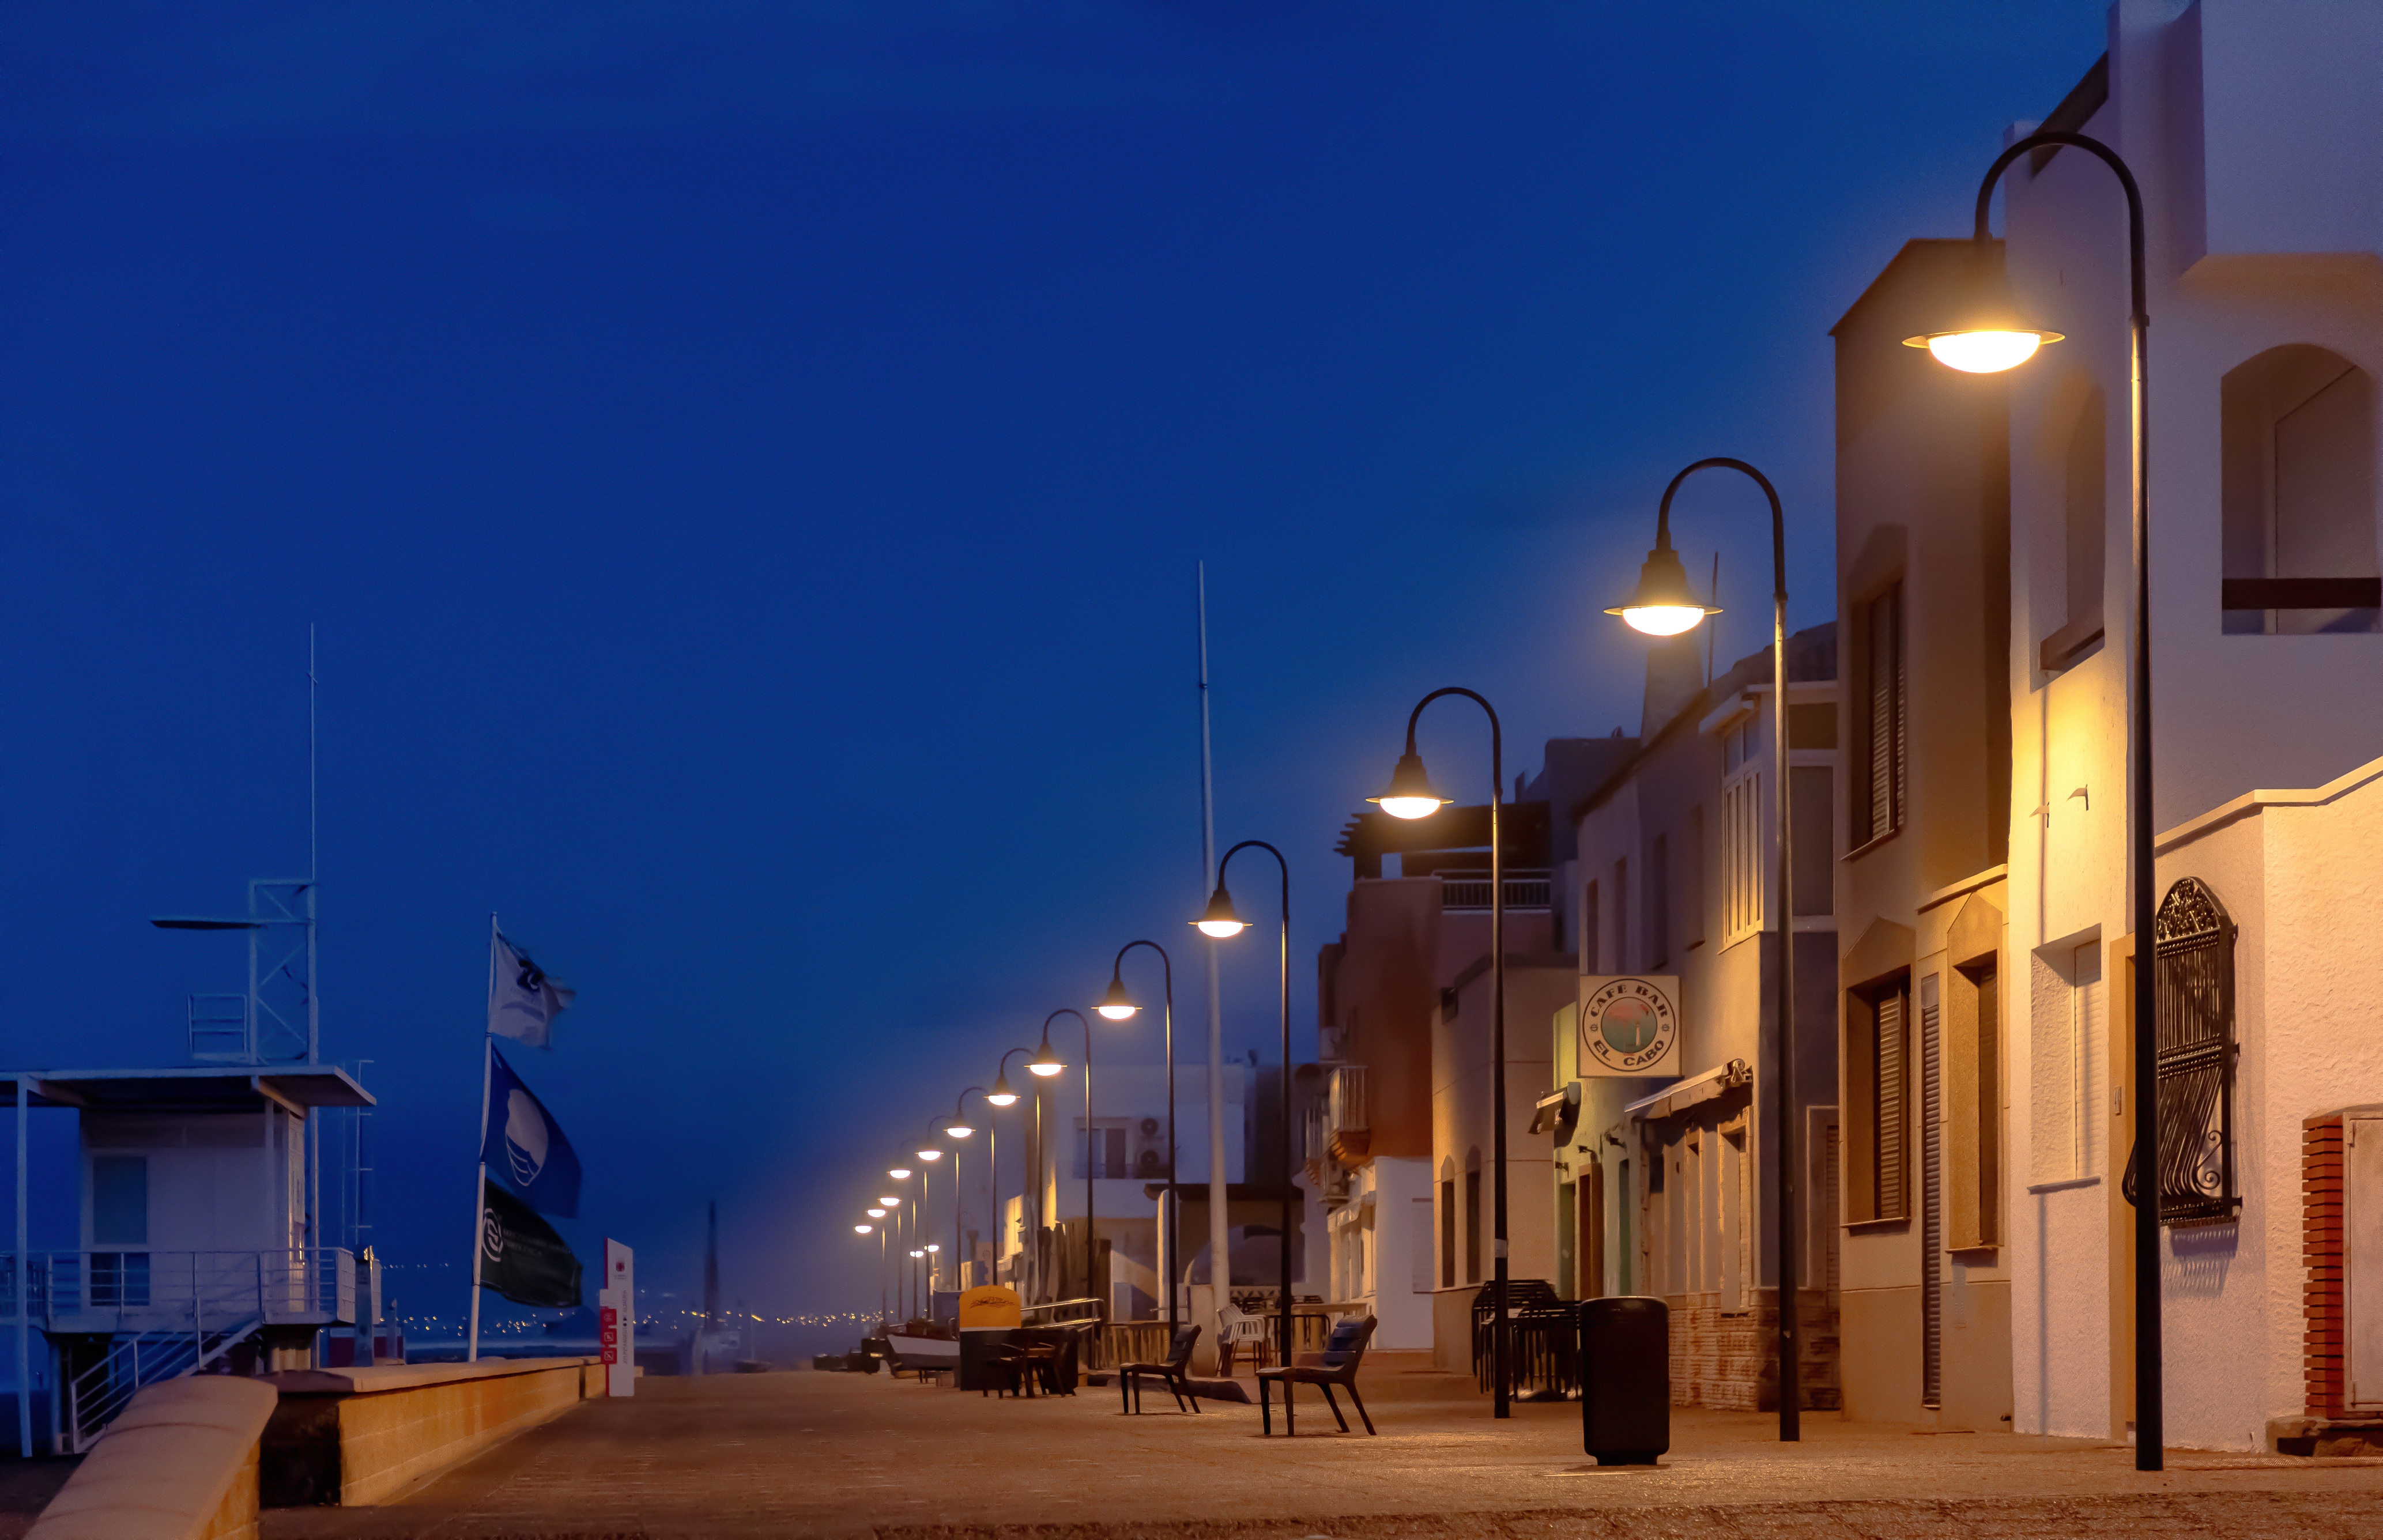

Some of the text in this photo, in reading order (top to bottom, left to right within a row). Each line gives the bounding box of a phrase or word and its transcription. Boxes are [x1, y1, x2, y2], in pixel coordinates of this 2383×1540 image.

[1590, 983, 1668, 1018] CAFE BAR
[1593, 1039, 1665, 1066] EL CABO
